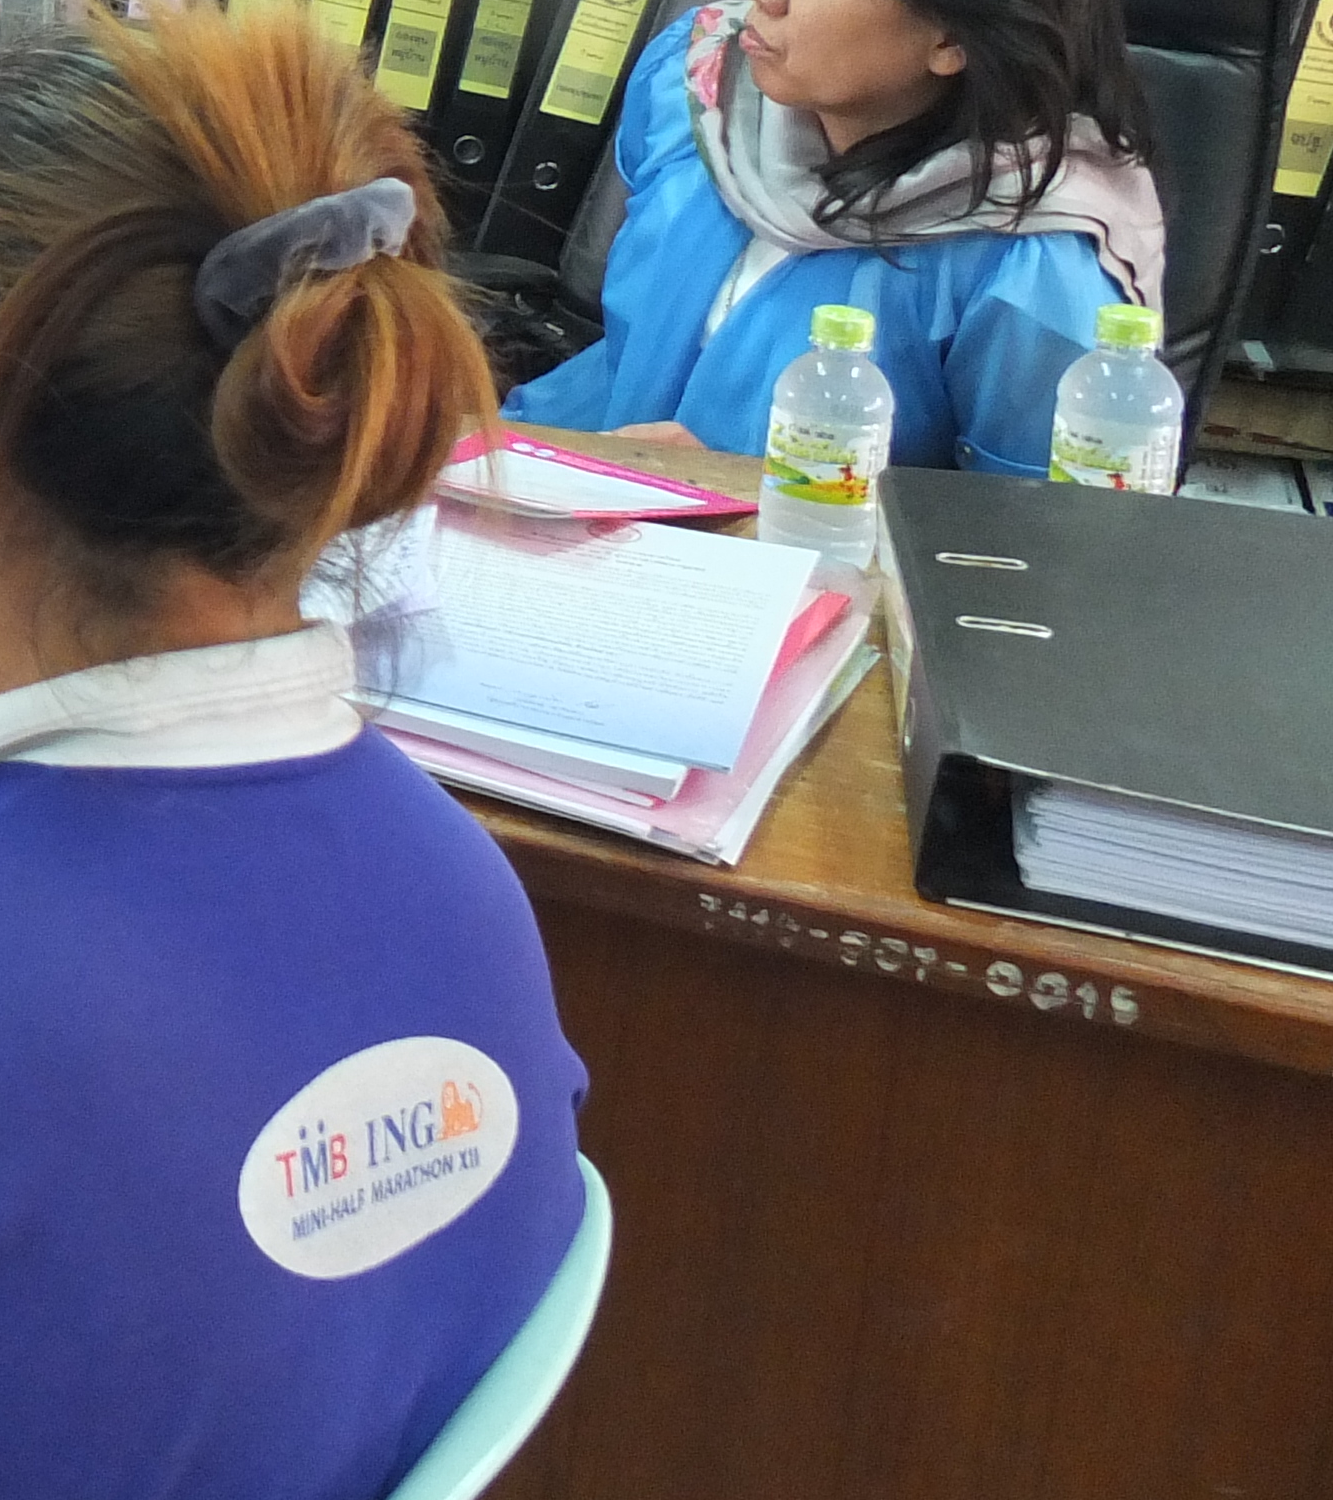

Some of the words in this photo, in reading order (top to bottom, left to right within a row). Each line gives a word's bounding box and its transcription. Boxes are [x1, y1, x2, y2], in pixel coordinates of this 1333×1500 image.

[275, 1134, 348, 1198] TMB
[366, 1101, 434, 1168] ING
[291, 1188, 365, 1241] MINI-HALF
[371, 1156, 453, 1204] MARATHON
[458, 1148, 480, 1171] XII
